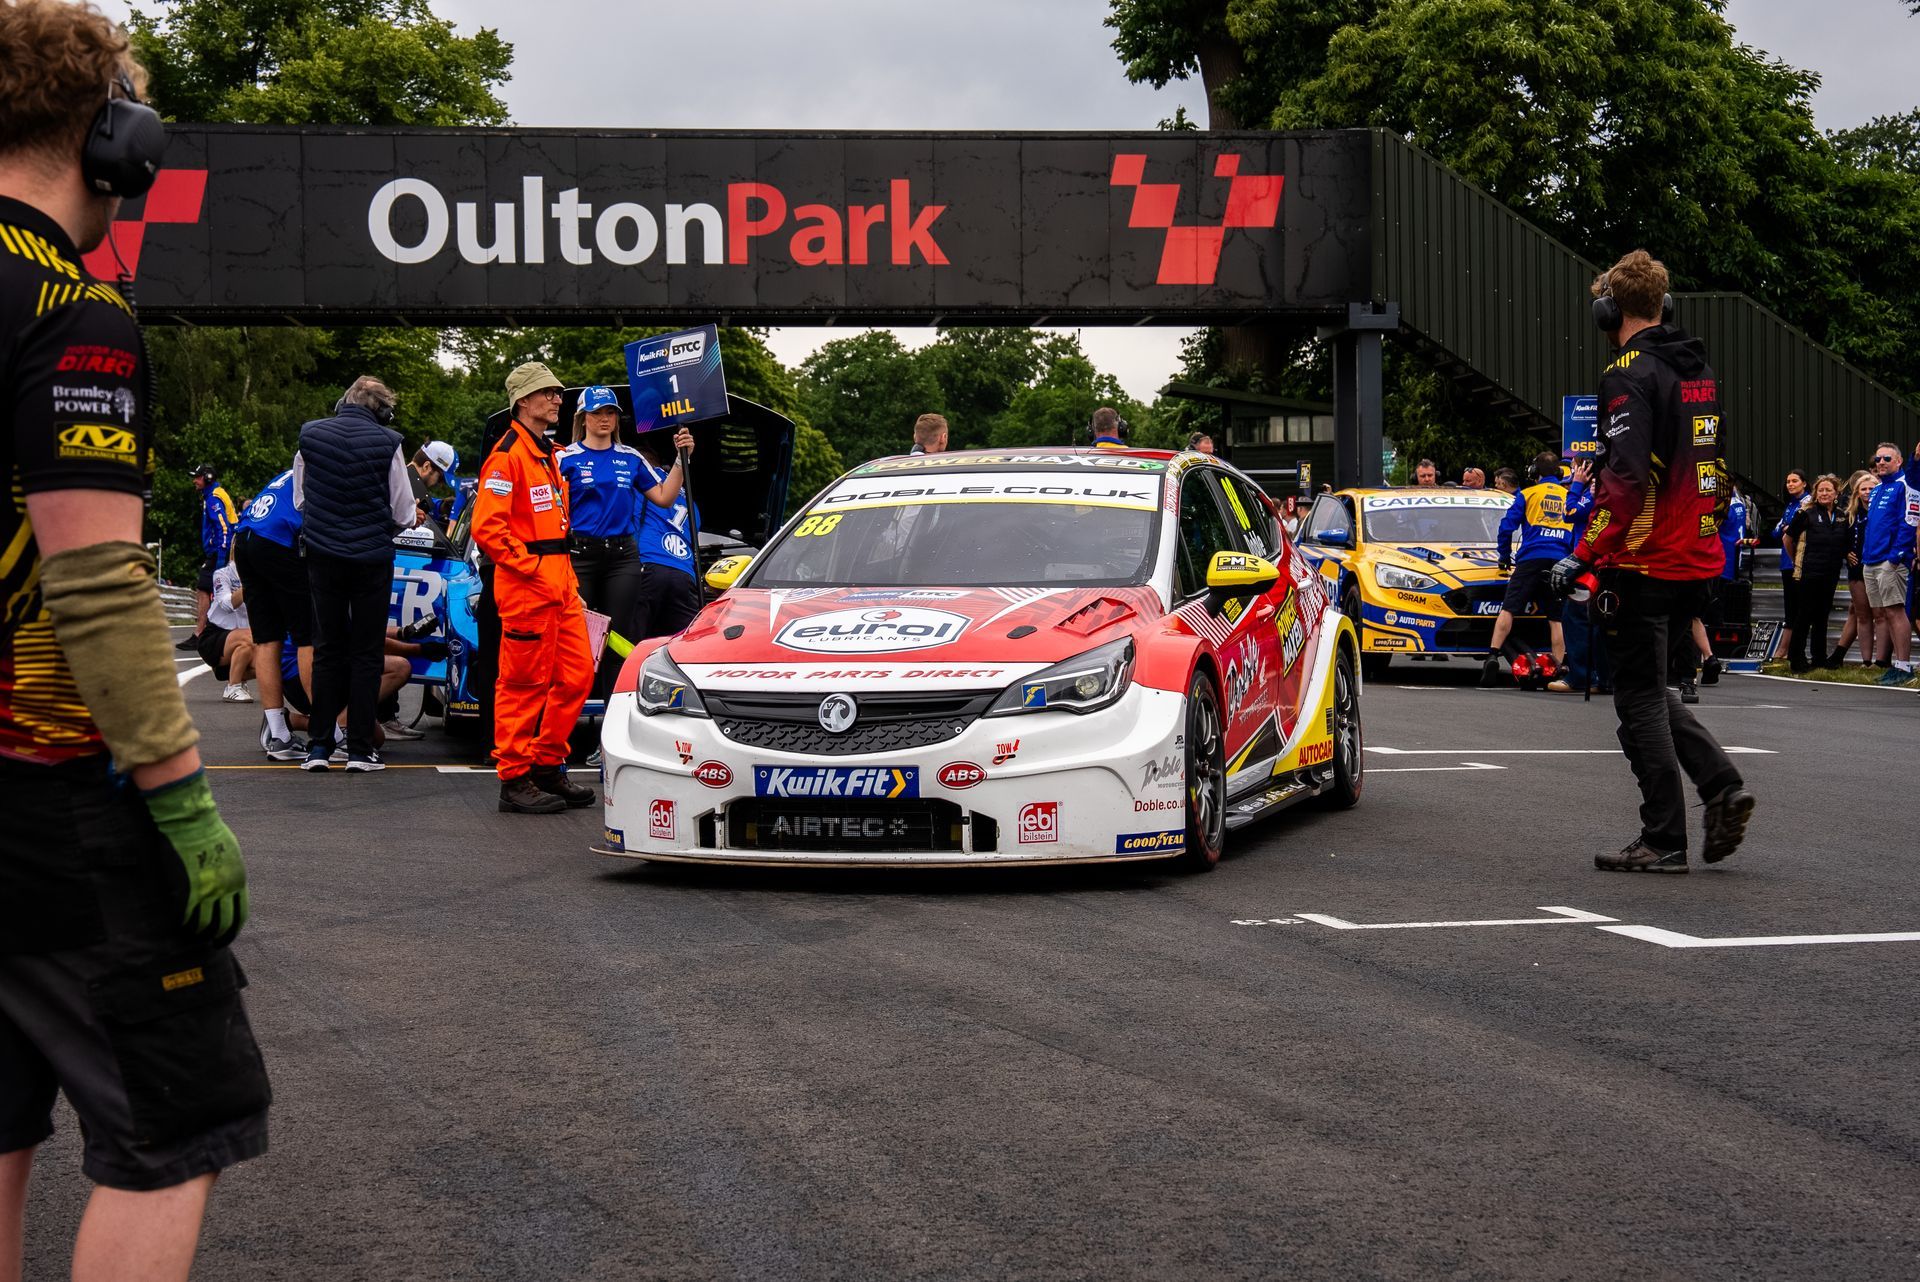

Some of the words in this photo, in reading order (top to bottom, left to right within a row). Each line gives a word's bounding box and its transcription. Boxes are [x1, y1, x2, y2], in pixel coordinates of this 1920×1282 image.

[639, 350, 665, 362] KwikFit
[672, 341, 701, 355] BTCC
[56, 355, 135, 379] DIRECT
[669, 374, 679, 393] 1
[53, 385, 113, 402] Bramley
[54, 401, 111, 414] POWER
[661, 398, 695, 418] HILL
[878, 457, 1004, 471] POWER
[1009, 455, 1143, 469] MAXED
[532, 488, 549, 498] NGK
[825, 486, 1152, 504] DOBLE.CO.UK
[1368, 496, 1515, 508] CATACLEAN
[1544, 500, 1562, 511] NAPA
[794, 514, 843, 537] 88
[1540, 527, 1565, 539] TEAM
[1218, 556, 1259, 566] PMR
[1398, 592, 1427, 604] OSRAM
[1277, 594, 1298, 638] POWER
[1399, 616, 1415, 625] AUTO
[1415, 619, 1436, 628] PARTS
[793, 623, 953, 639] eurol
[1283, 614, 1304, 667] MAXED
[706, 670, 797, 679] MOTOR
[804, 670, 892, 679] PARTS
[901, 670, 1004, 678] DIRECT
[682, 742, 693, 753] TOW
[996, 743, 1012, 755] TOW
[1299, 740, 1332, 766] AUTOCAR
[699, 768, 727, 781] ABS
[945, 770, 980, 782] ABS
[1139, 755, 1182, 793] Doble
[767, 768, 889, 797] KwikFit
[651, 802, 674, 827] febi
[1018, 803, 1056, 831] febi
[652, 827, 671, 837] bilstein
[771, 816, 884, 837] AIRTEC
[1023, 832, 1054, 842] bilstein
